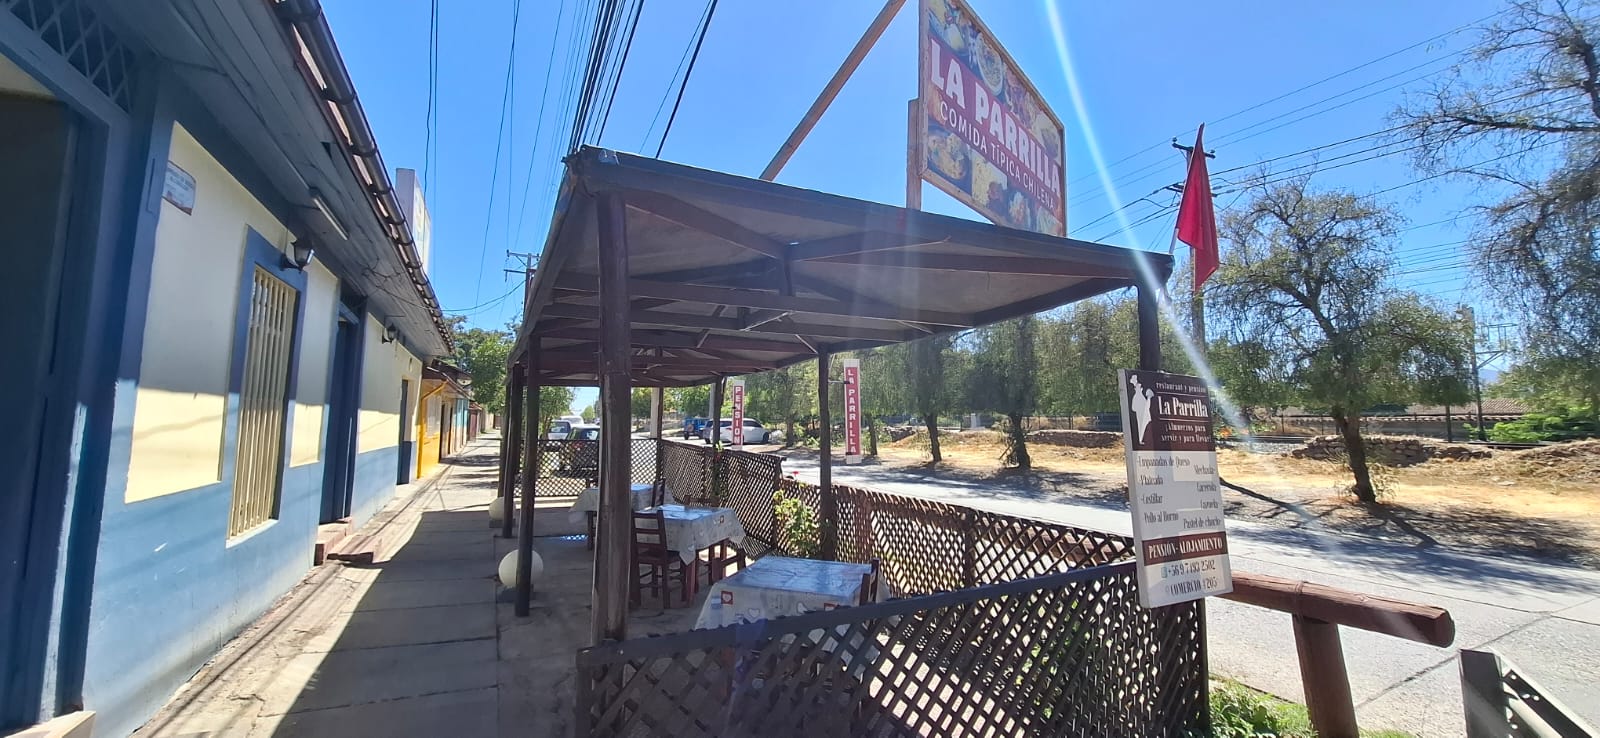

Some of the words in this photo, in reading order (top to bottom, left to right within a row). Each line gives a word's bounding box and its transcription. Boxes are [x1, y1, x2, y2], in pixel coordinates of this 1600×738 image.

[931, 39, 966, 109] LA
[975, 83, 1060, 197] PARRILLA
[940, 101, 987, 153] COMIDA
[1023, 172, 1055, 209] CHILENA
[847, 369, 855, 385] LA
[1158, 396, 1171, 415] La
[1172, 397, 1209, 417] Parrilla
[734, 386, 742, 446] PENSION
[848, 388, 857, 453] PARRILLA
[1170, 579, 1202, 596] COMERCIO
